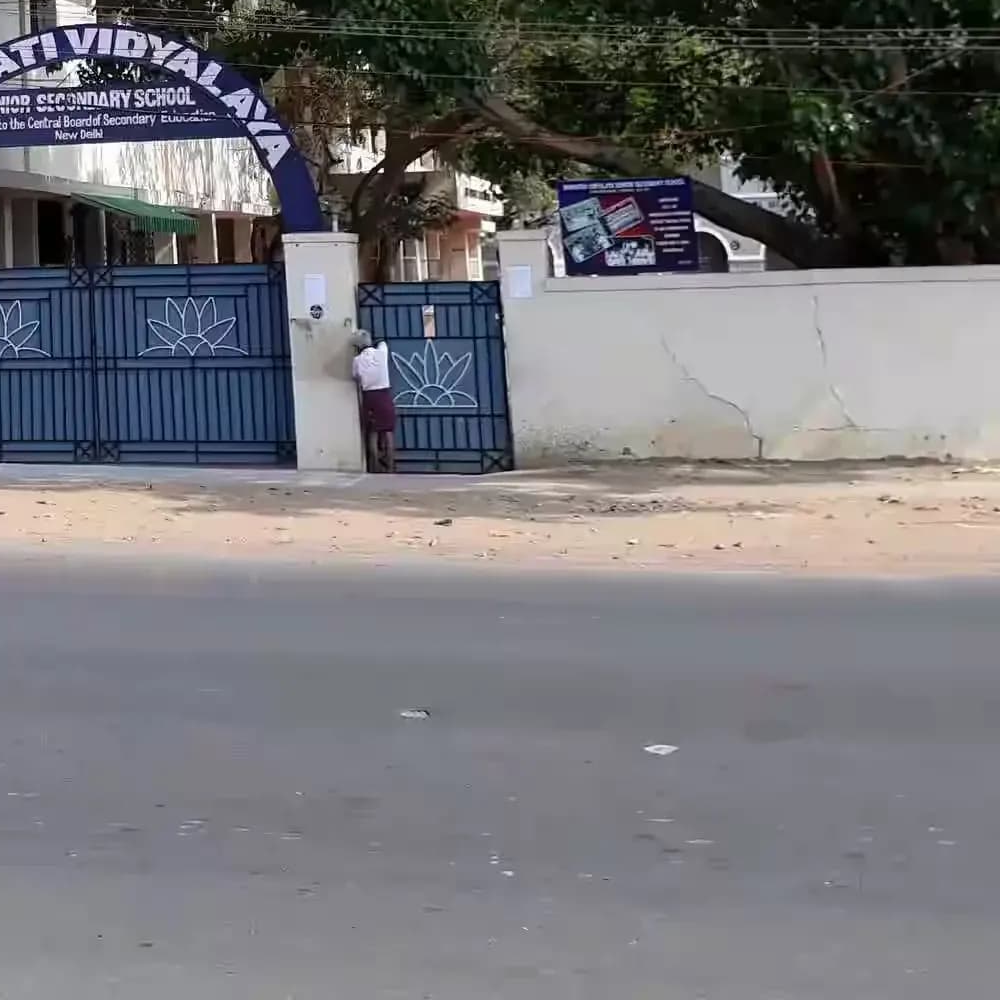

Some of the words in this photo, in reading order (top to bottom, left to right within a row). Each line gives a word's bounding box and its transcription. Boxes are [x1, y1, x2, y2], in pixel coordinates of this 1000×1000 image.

[36, 90, 132, 112] SECONDARY
[134, 86, 196, 108] SCHOOL
[64, 28, 291, 169] VIDYALAYA
[10, 117, 25, 130] the
[27, 115, 61, 129] Central
[63, 114, 92, 128] Board
[92, 113, 103, 126] of
[103, 111, 156, 127] Secondary
[55, 129, 78, 140] New
[80, 128, 103, 139] Delhi
